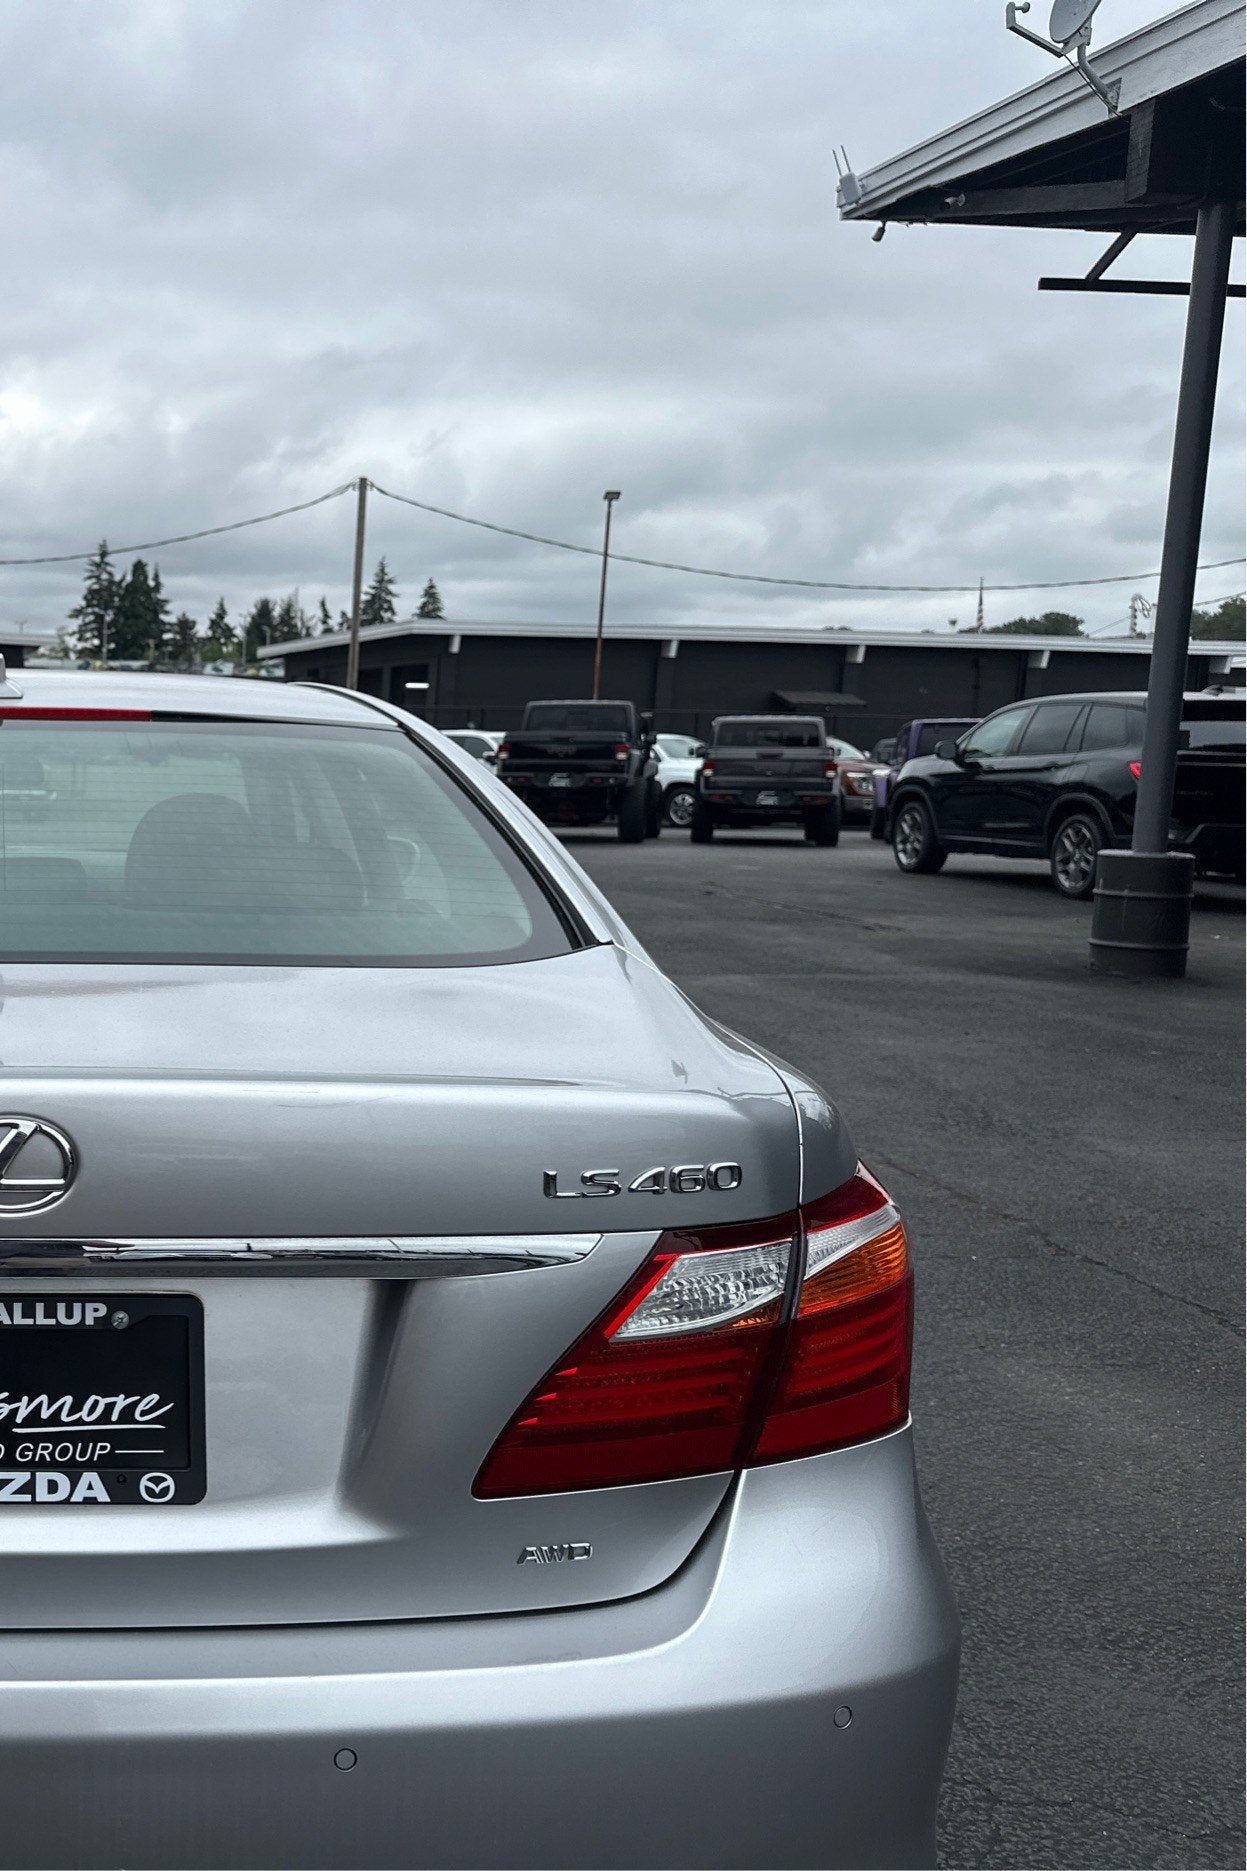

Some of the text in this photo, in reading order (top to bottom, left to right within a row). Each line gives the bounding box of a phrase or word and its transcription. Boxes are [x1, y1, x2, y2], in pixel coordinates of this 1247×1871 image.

[543, 1161, 743, 1199] LS 460
[15, 1442, 112, 1462] GROUP
[516, 1542, 593, 1565] AWD
